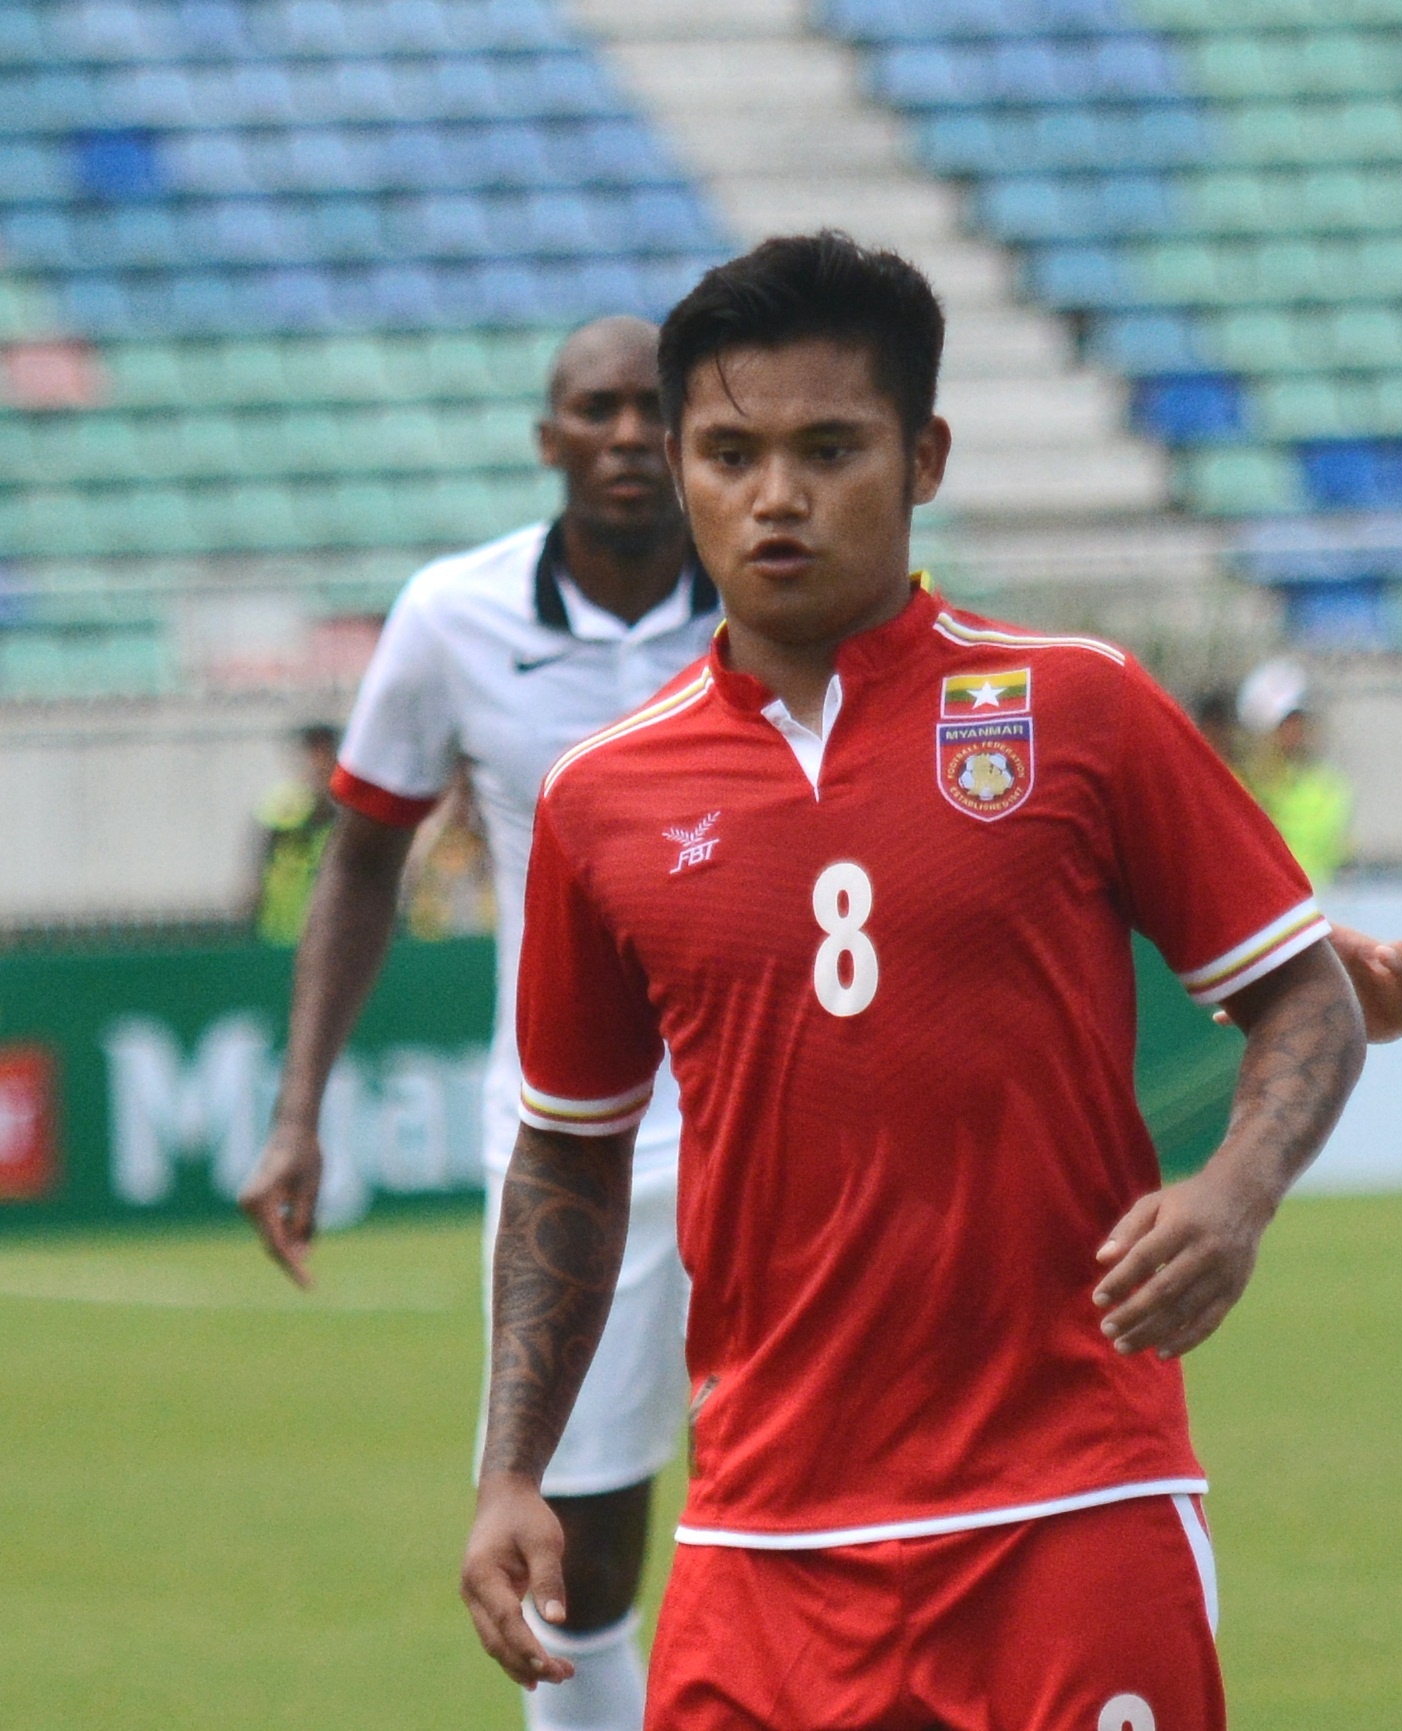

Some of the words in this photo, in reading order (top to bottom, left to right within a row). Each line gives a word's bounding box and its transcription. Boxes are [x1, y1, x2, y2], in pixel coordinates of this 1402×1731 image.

[945, 725, 1023, 739] MYANMAR
[948, 745, 978, 779] FOOTBALL
[982, 741, 1025, 778] FEDERATION
[949, 787, 1008, 810] ESTABLISHED
[669, 838, 720, 875] FBT
[812, 862, 879, 1018] 8
